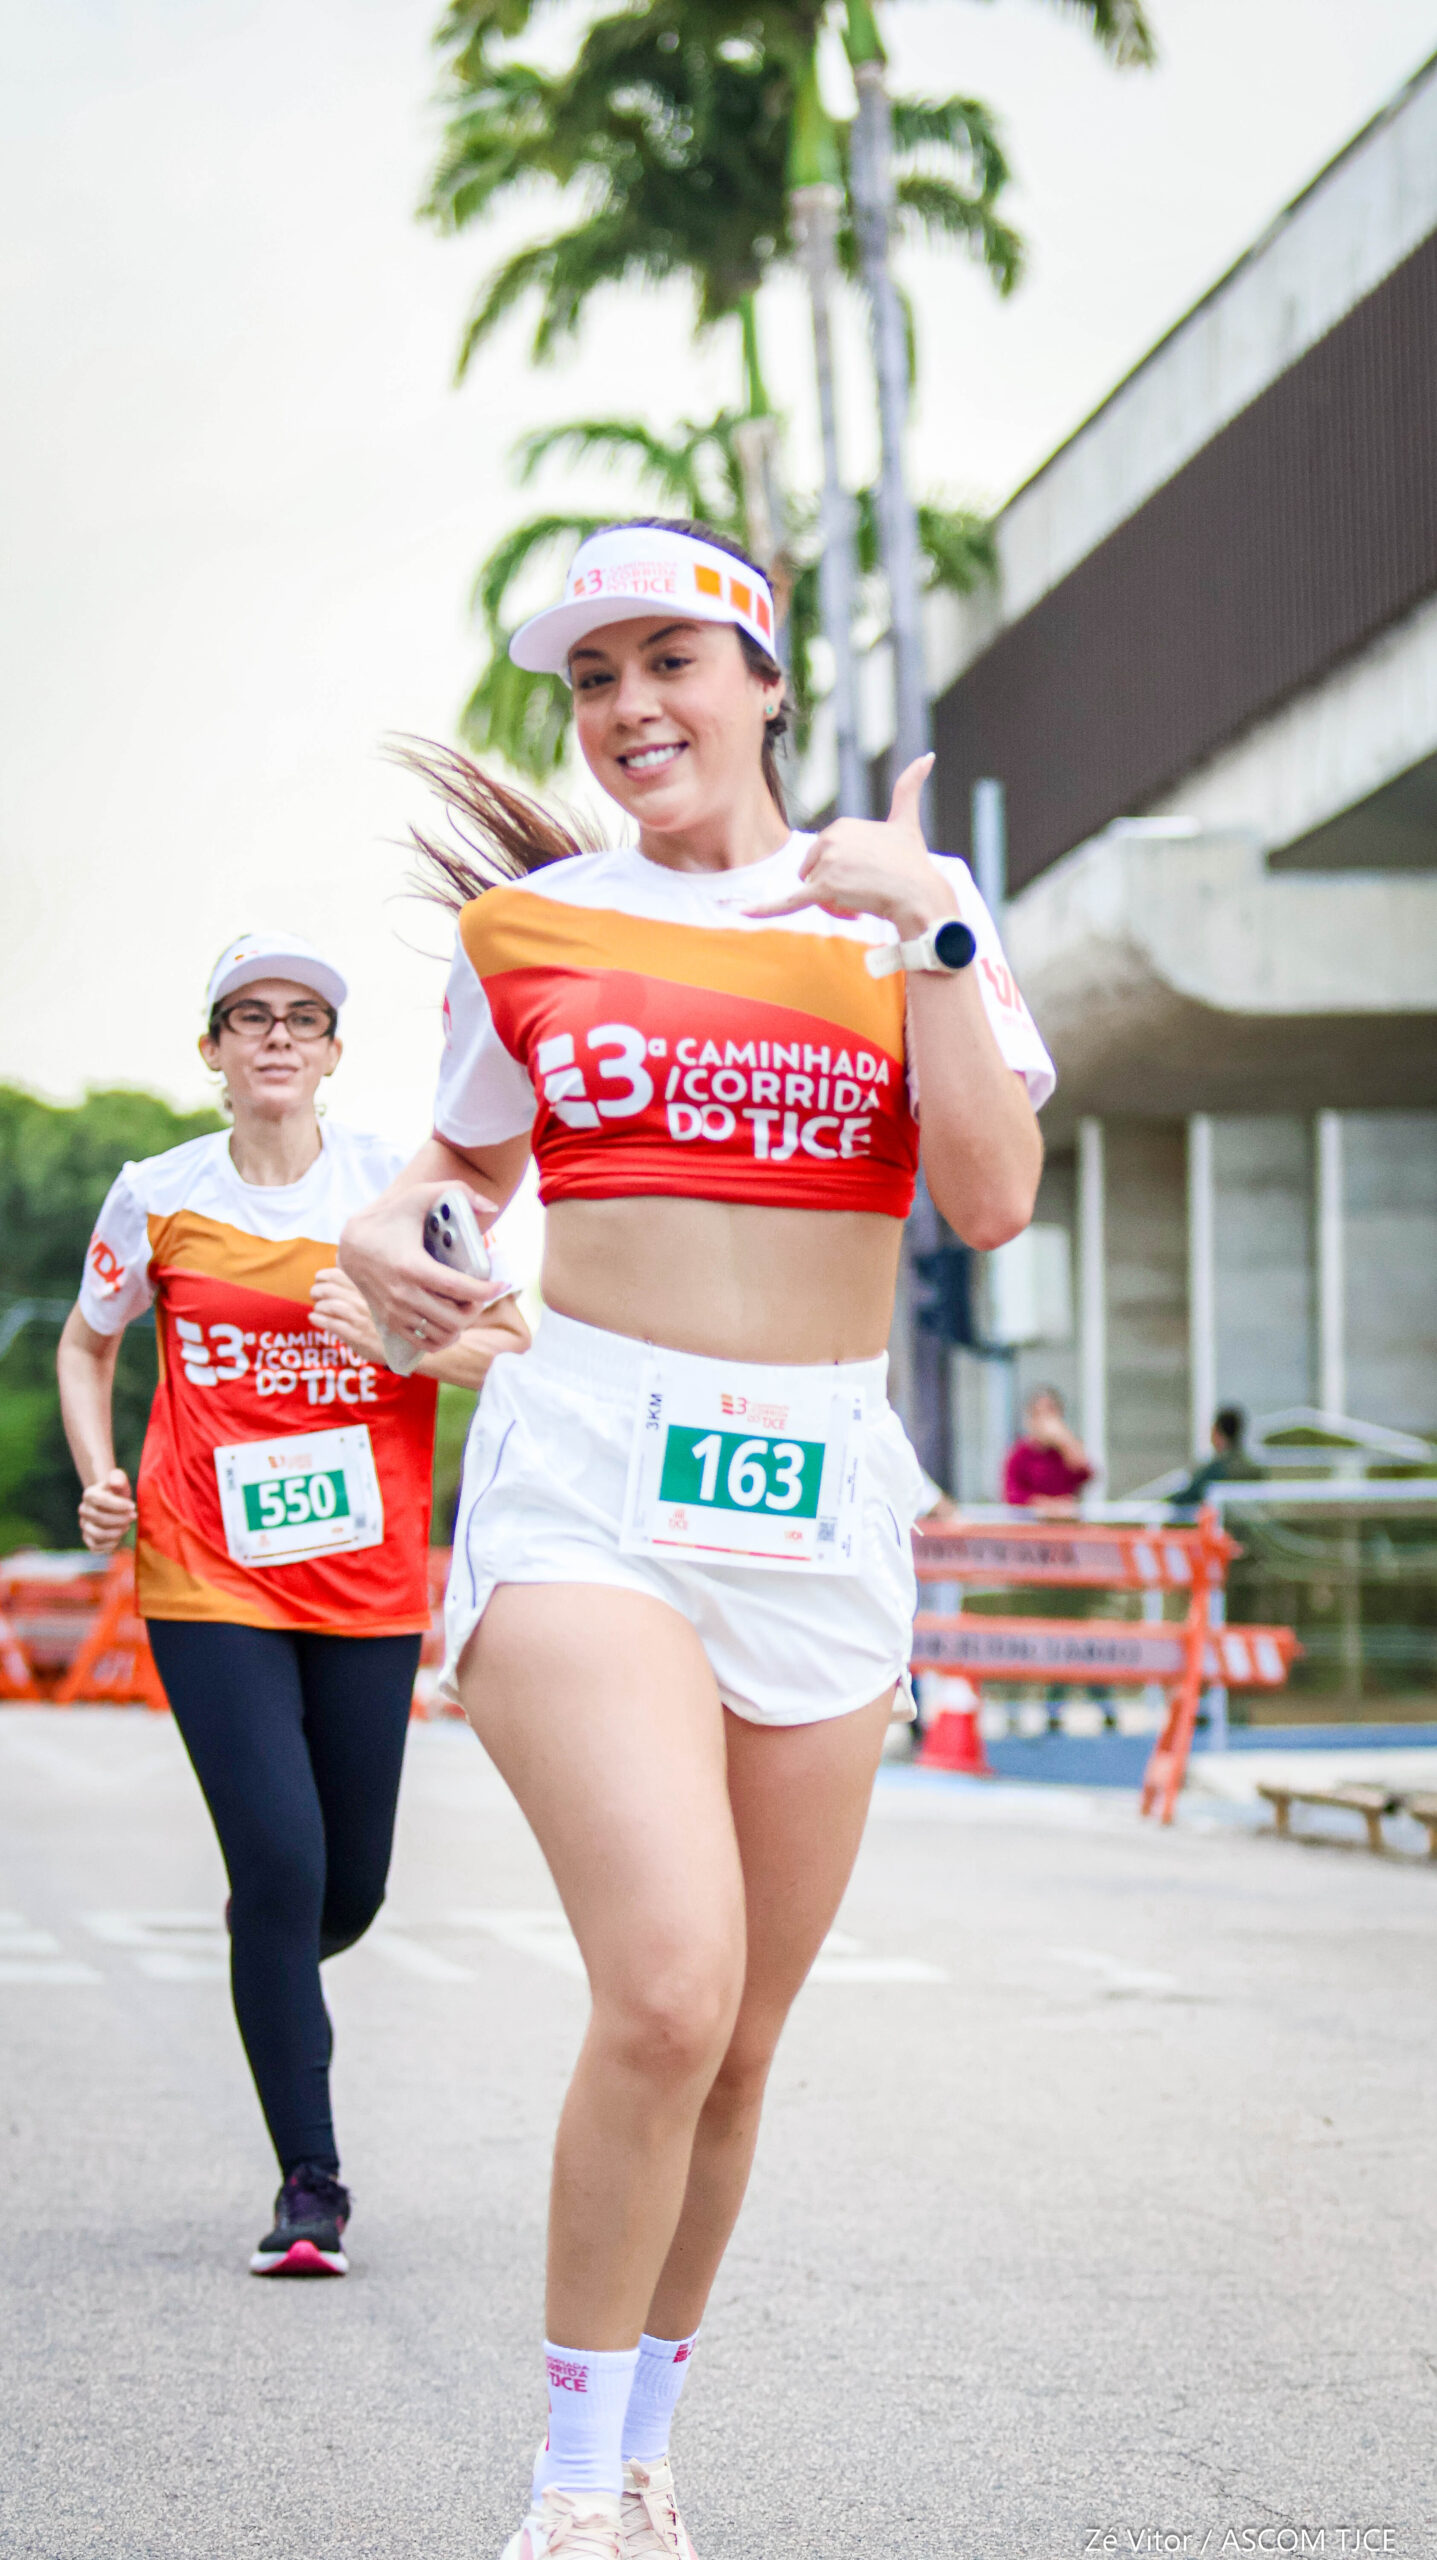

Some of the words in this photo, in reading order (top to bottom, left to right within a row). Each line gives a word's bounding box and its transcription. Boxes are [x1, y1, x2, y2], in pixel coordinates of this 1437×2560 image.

[632, 577, 677, 594] TJCE
[676, 1038, 890, 1086] CAMINHADA
[666, 1102, 737, 1142] DO
[742, 1107, 873, 1161] TJCE
[256, 1368, 298, 1396] DO
[300, 1366, 378, 1405] TJCE
[646, 1393, 663, 1430] 3KM
[691, 1433, 806, 1512] 163
[258, 1474, 337, 1528] 550
